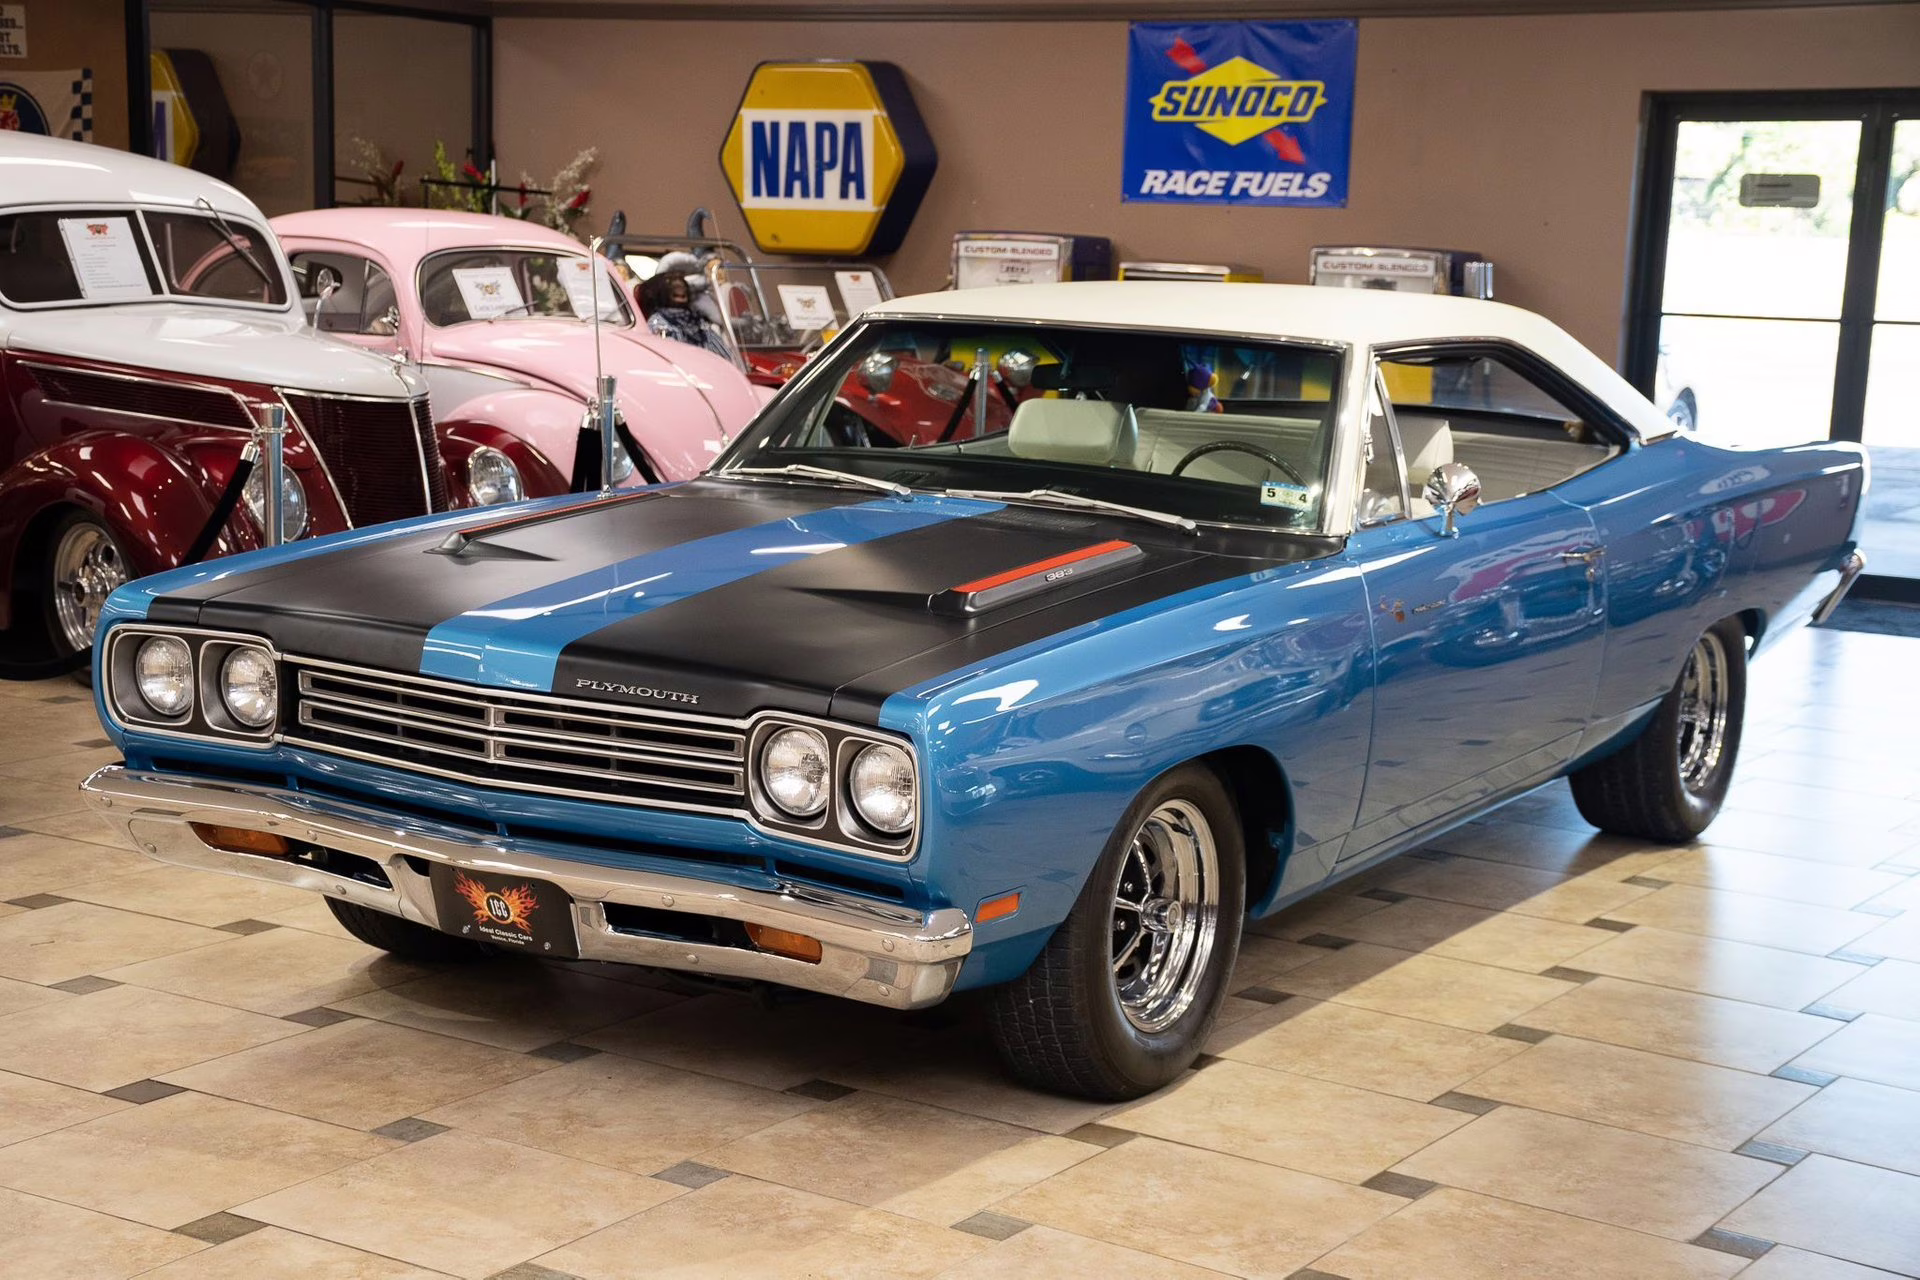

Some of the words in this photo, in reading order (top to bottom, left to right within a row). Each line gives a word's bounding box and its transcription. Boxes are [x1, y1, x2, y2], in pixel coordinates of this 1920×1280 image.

[1158, 85, 1318, 118] SUNOCO
[751, 121, 866, 200] NAPA
[1140, 169, 1230, 196] RACE
[1230, 171, 1332, 198] FUELS
[1267, 488, 1276, 498] 5
[1298, 493, 1307, 504] 4
[1046, 567, 1074, 581] 383
[576, 678, 700, 705] PLYMOUTH
[489, 899, 508, 918] ICC
[495, 929, 517, 939] Classic
[518, 933, 533, 942] Cars
